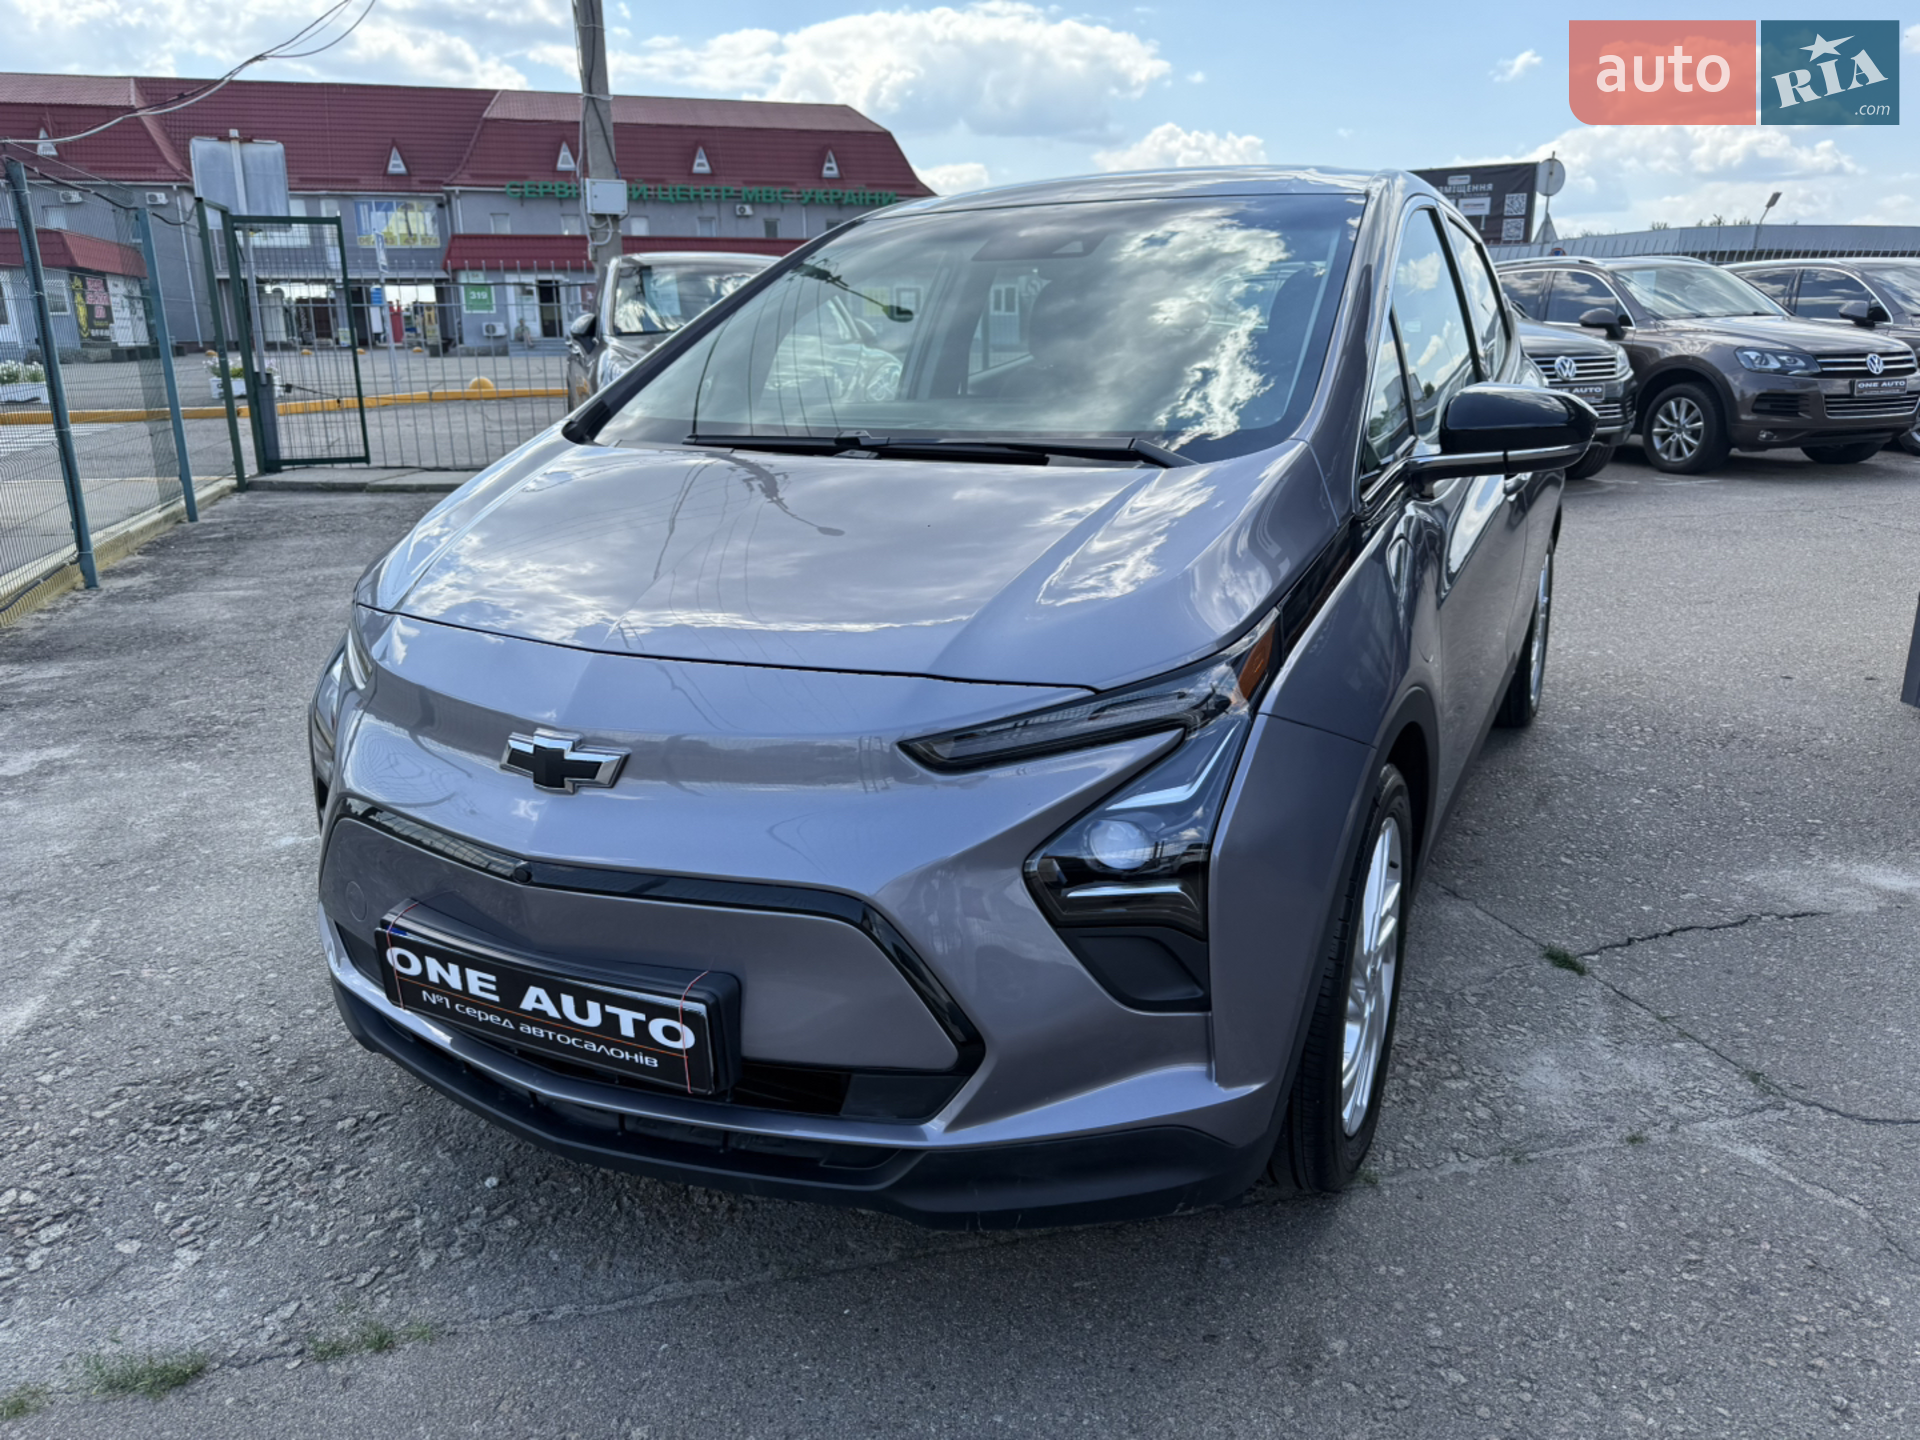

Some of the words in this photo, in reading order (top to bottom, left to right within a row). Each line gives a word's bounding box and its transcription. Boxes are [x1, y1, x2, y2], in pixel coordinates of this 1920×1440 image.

[505, 179, 649, 200] СЕРВІЙ
[658, 184, 735, 204] ЦЕНТР
[741, 185, 794, 204] МВС
[801, 185, 898, 206] УКРАЇНИ
[469, 291, 488, 300] 319
[1572, 386, 1603, 394] AUTO
[386, 946, 500, 1003] ONE
[519, 985, 696, 1050] AUTO
[455, 1003, 516, 1030] серед
[519, 1023, 659, 1068] автосалонів
